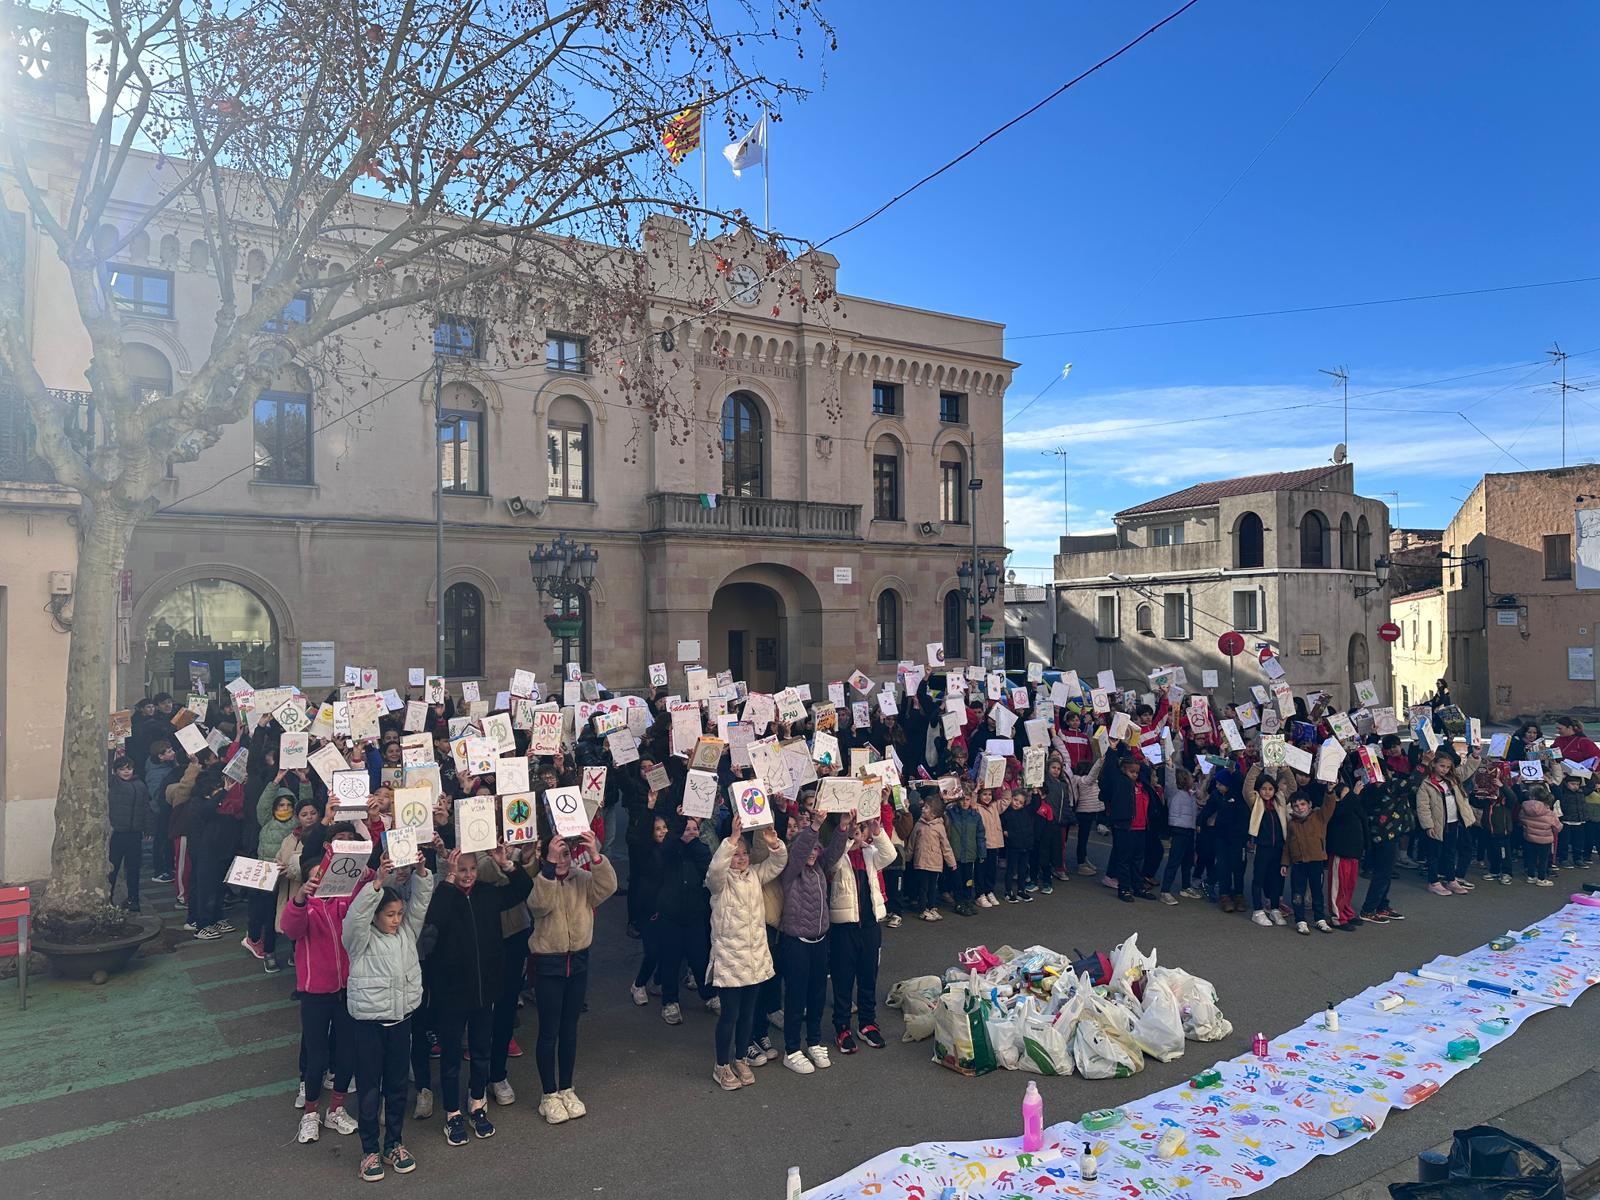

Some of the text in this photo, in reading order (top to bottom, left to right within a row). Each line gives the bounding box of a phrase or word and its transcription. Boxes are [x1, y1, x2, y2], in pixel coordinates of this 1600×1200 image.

[540, 713, 557, 726] NO
[783, 709, 798, 721] PAU
[506, 826, 533, 842] PAU
